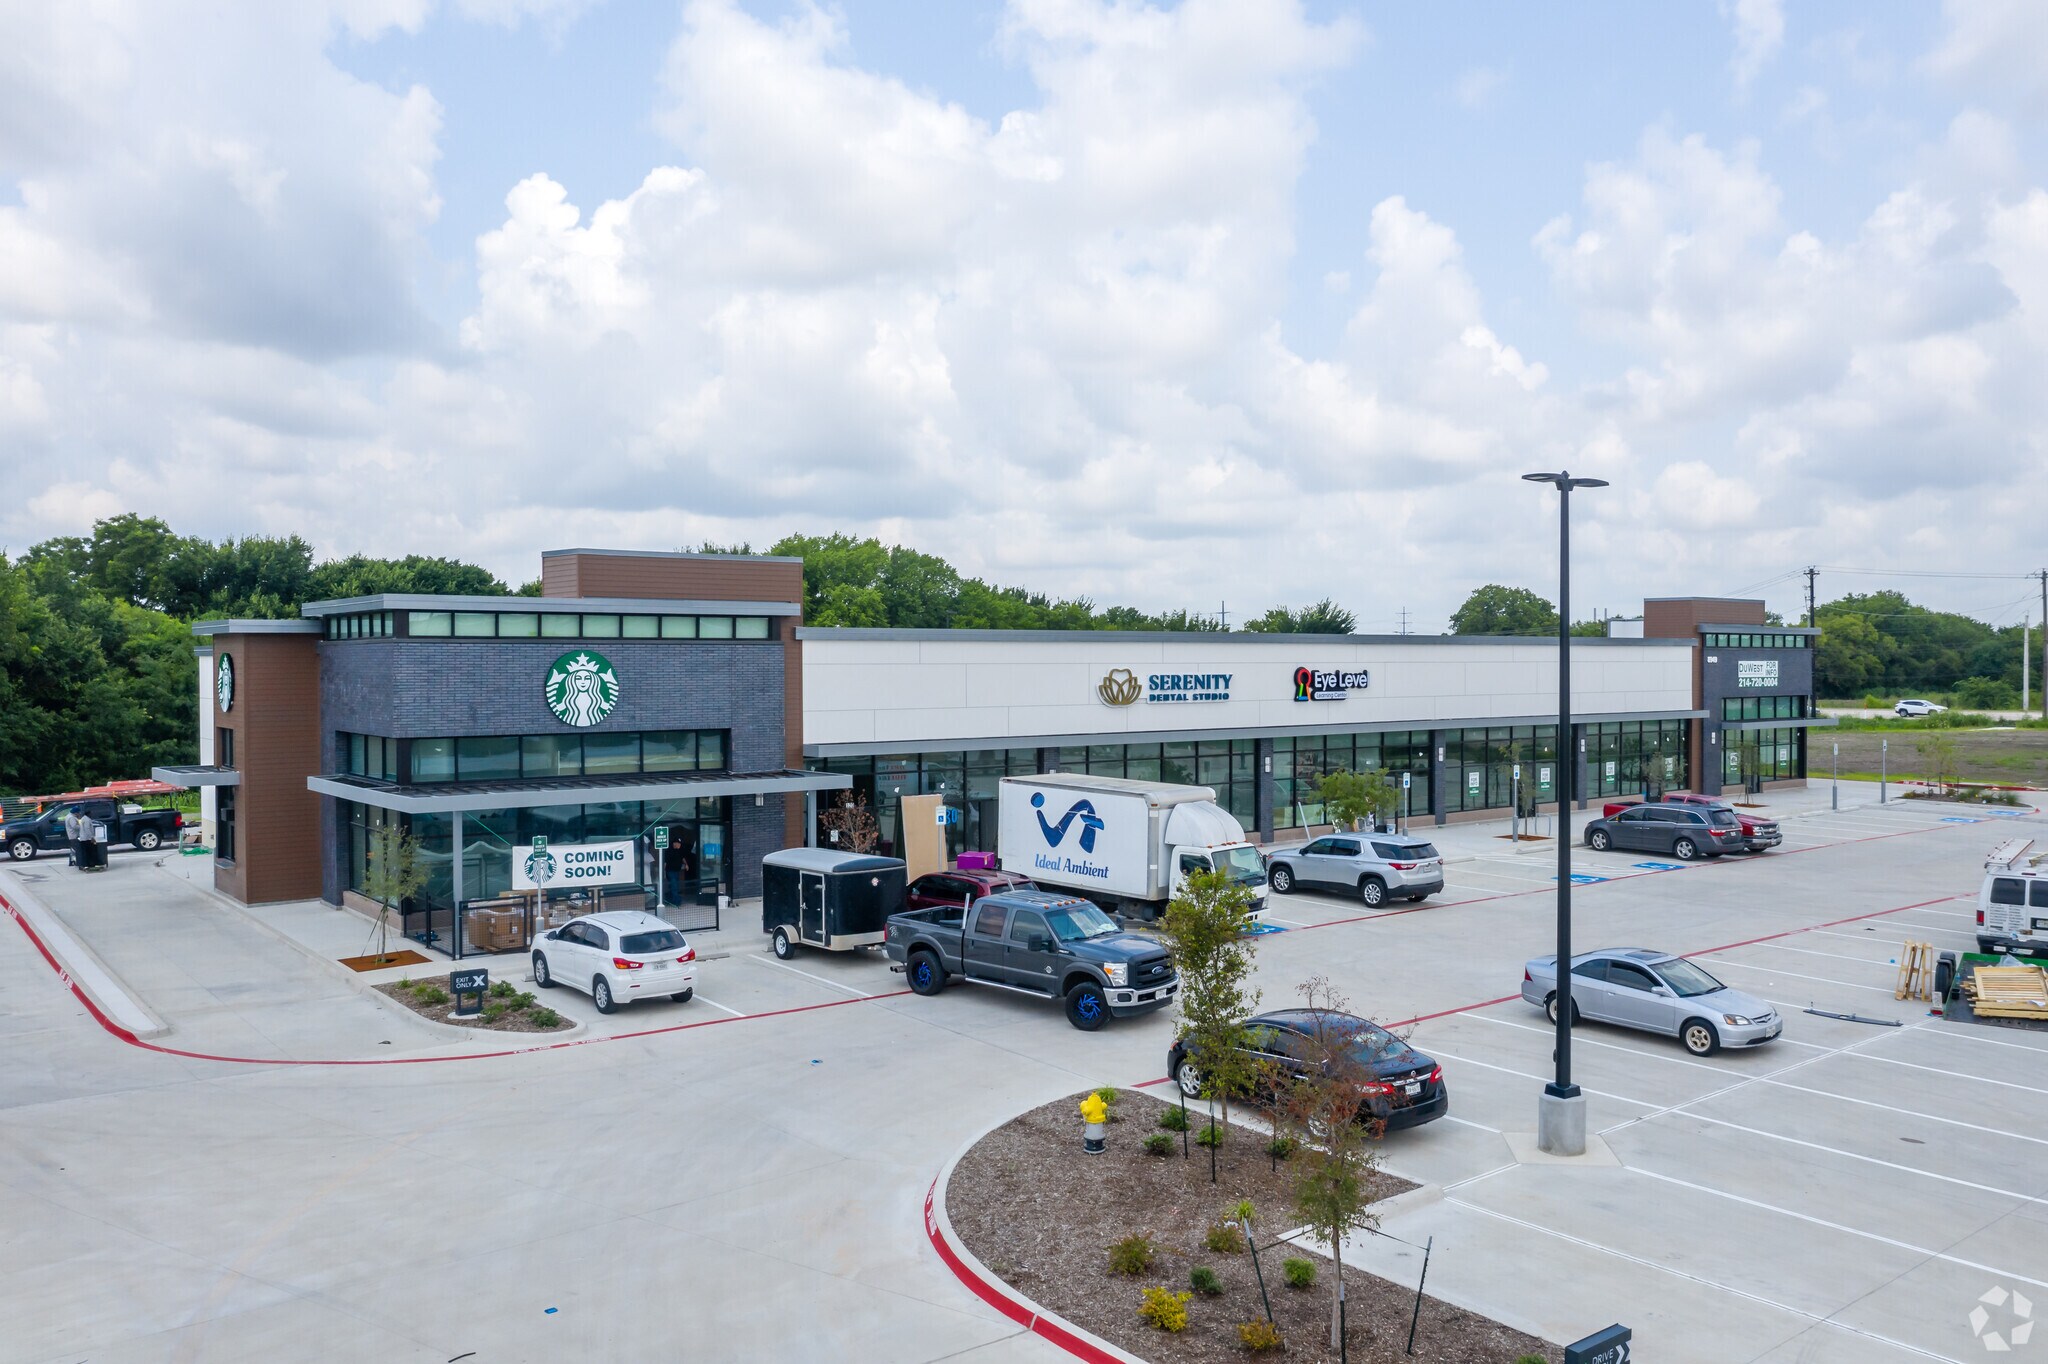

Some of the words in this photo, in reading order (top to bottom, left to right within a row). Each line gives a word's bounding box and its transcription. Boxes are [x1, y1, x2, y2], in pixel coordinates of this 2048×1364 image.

[1766, 661, 1776, 669] FOR
[1149, 674, 1233, 691] SERENITY
[1314, 671, 1337, 691] Eye
[1738, 677, 1778, 687] 214-720-0004
[1149, 694, 1189, 702] DENTAL
[1192, 693, 1230, 701] STUDIO
[564, 850, 624, 864] COMING
[564, 865, 611, 879] SOON!
[1035, 853, 1061, 871] Ideal
[1063, 858, 1109, 879] Ambient
[456, 976, 469, 984] EXIT
[1592, 1348, 1614, 1364] DRIVE
